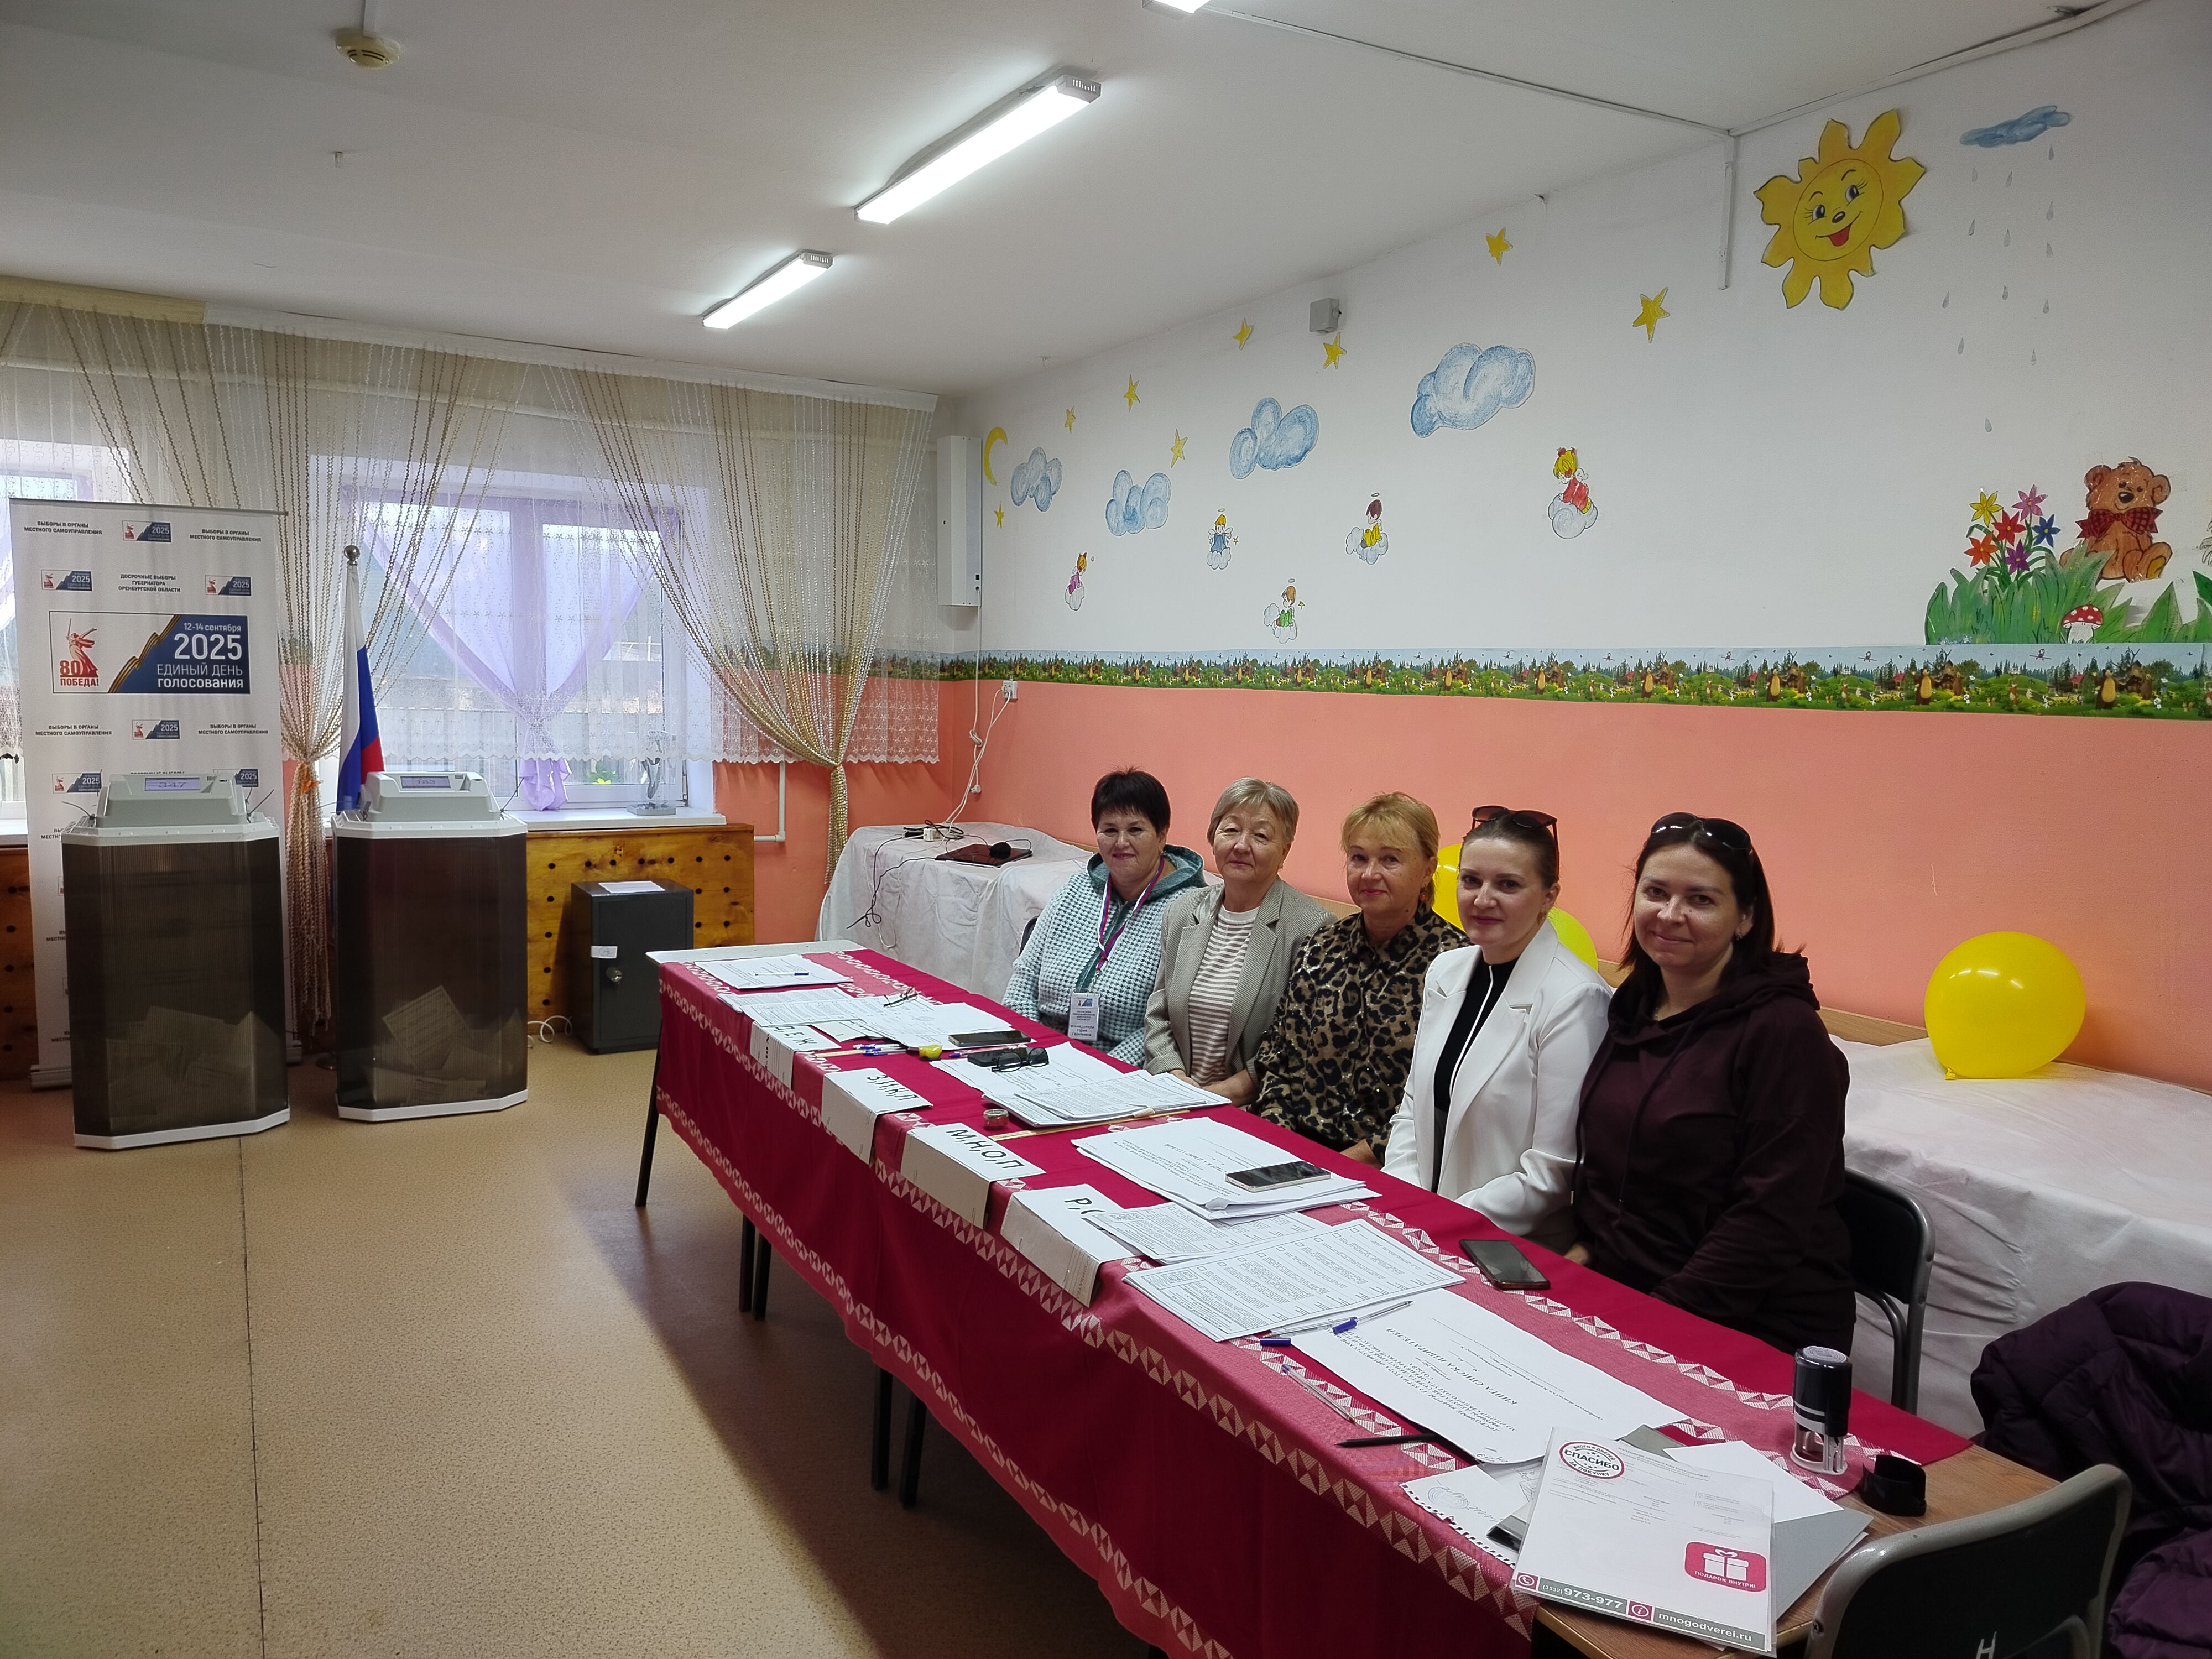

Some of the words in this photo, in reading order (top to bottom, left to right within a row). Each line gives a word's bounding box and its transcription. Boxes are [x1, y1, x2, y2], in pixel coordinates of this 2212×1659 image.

[184, 623, 204, 631] 12-14
[205, 624, 242, 633] сентября
[174, 633, 242, 660] 2025
[60, 660, 81, 675] 80
[157, 662, 208, 676] ЕДИНЫЙ
[212, 665, 243, 677] ДЕНЬ
[60, 678, 99, 687] ПОБЕДА!
[158, 678, 243, 688] голосования
[946, 1129, 1025, 1168] М,Н,О,П
[1383, 1328, 1448, 1362] ИЗБИРАТЕЛЕЙ
[1443, 1362, 1486, 1386] СПИСКА
[1481, 1386, 1519, 1405] КНИГА
[1564, 1449, 1620, 1470] СПАСИБО
[1595, 1447, 1616, 1460] ДВЕРЕЙ
[1578, 1466, 1610, 1477] ПОКУПКУ
[1694, 1571, 1726, 1583] ПОДАРОК
[1728, 1579, 1756, 1589] ВНУТРИ!
[1542, 1584, 1563, 1594] (3532)
[1564, 1588, 1623, 1609] 973-977
[1658, 1613, 1752, 1642] mnogodverei.ru
